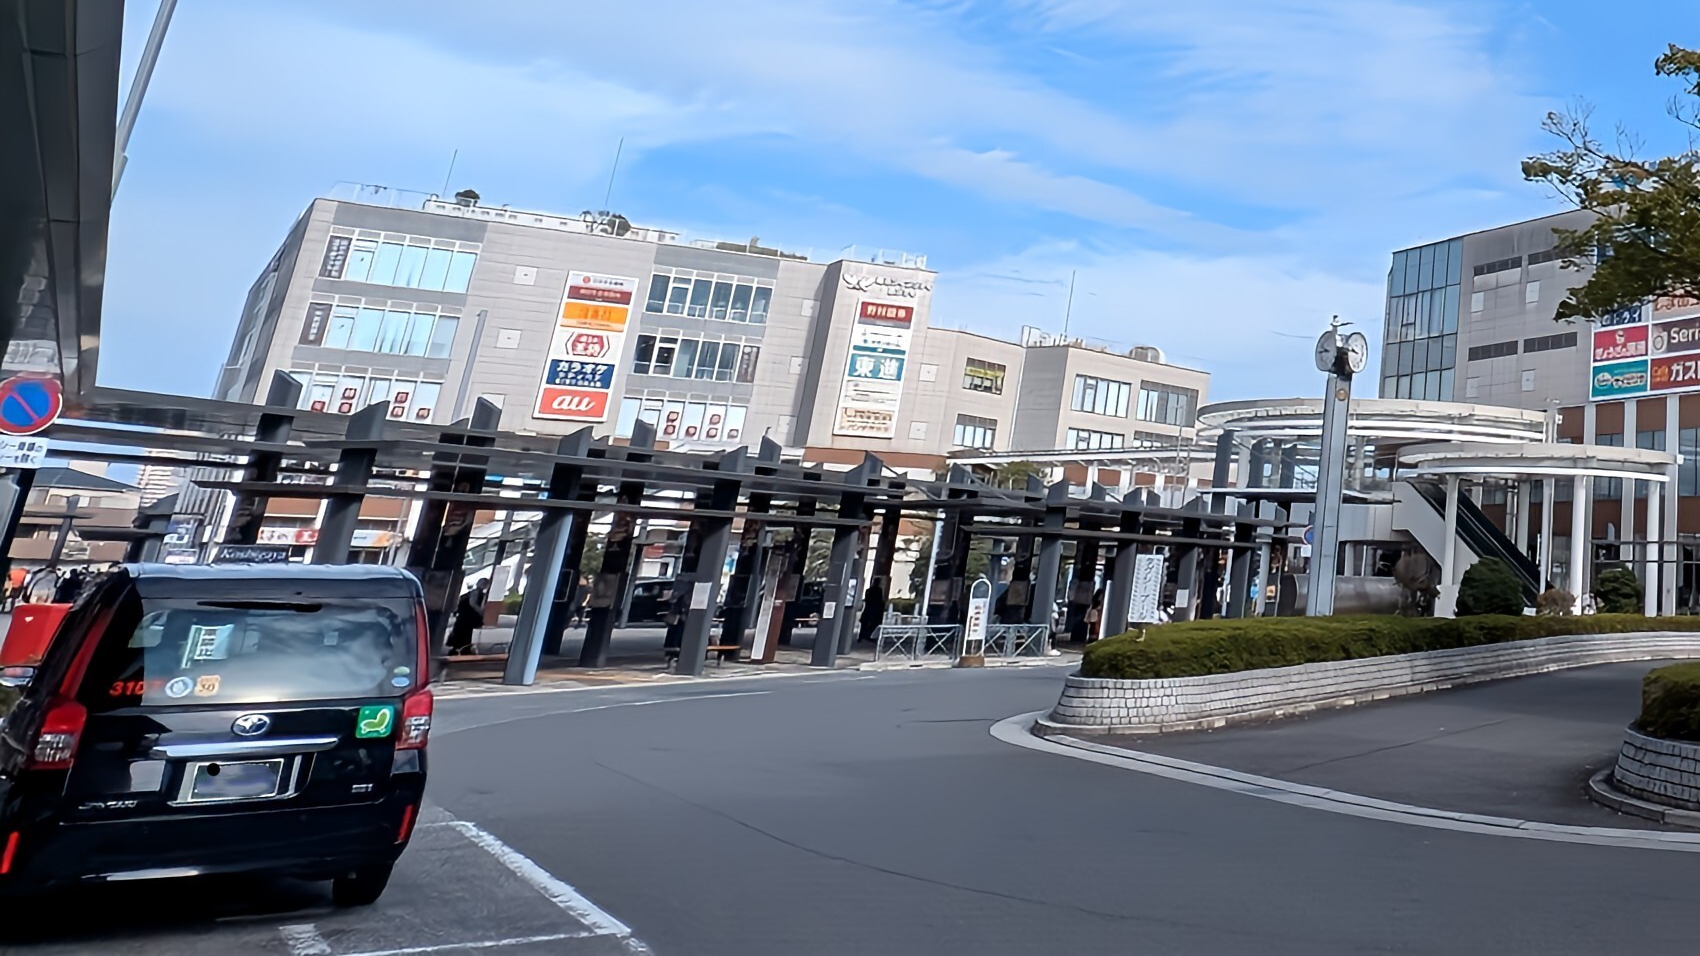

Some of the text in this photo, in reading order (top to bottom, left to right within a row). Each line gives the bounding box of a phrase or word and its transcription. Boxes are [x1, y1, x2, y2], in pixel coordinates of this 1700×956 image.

[556, 361, 608, 375] カラオケ
[852, 356, 899, 379] 東進
[552, 395, 596, 411] au
